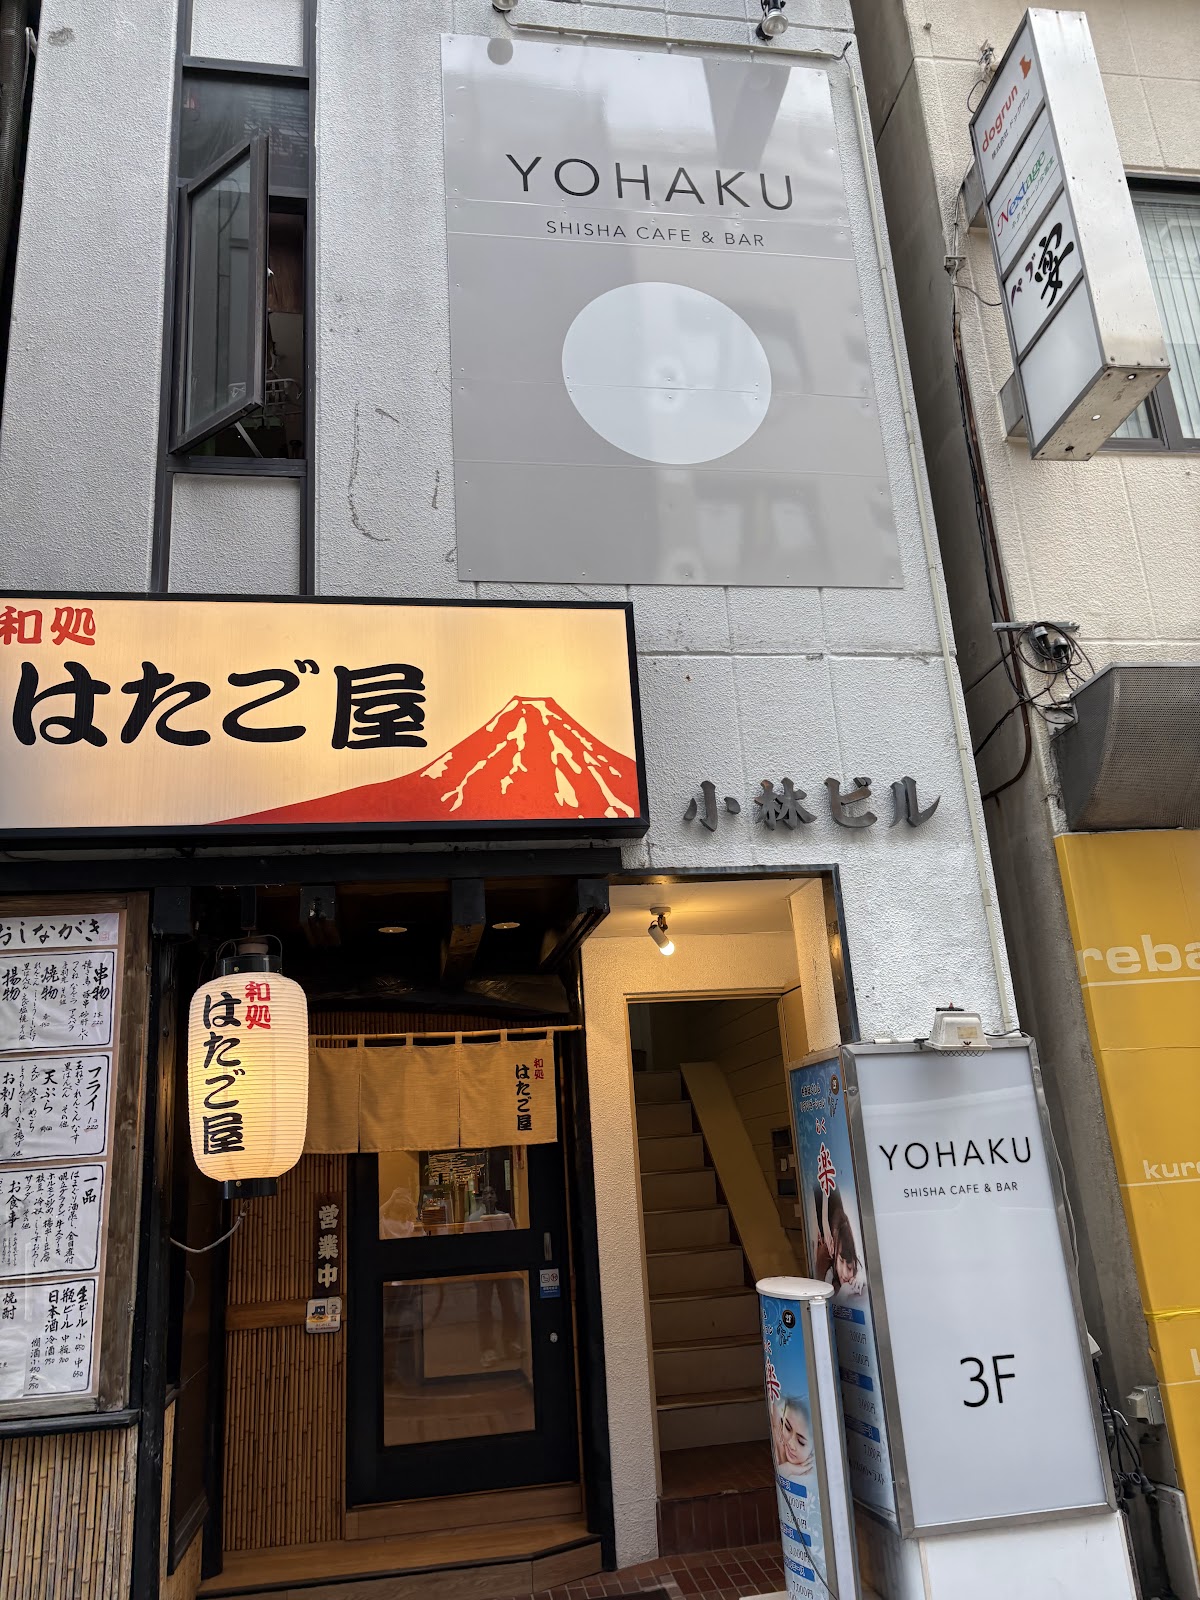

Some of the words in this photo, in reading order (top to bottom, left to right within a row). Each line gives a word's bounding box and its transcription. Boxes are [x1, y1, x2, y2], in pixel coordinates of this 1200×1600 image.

[982, 85, 1018, 152] dogrun
[505, 153, 794, 211] YOHAKU
[998, 151, 1046, 237] Nextage
[546, 220, 626, 239] SHISHA
[636, 226, 692, 242] CAFE
[701, 230, 715, 244] &
[724, 232, 765, 248] BAR
[1011, 253, 1036, 308] パブ
[0, 606, 97, 646] 和処
[12, 658, 428, 750] はたご屋
[682, 776, 942, 832] 小林ビル
[1, 965, 22, 1002] 揚物
[40, 964, 60, 1001] 焼物
[91, 962, 111, 1001] 串物
[245, 980, 272, 1030] 和処
[40, 1069, 59, 1114] 天ぷら
[84, 1066, 102, 1112] フライ
[202, 991, 246, 1156] はたご屋
[533, 1058, 545, 1080] 和処
[0, 1071, 16, 1119] お刺身
[515, 1063, 533, 1131] はたご屋
[879, 1136, 1031, 1171] YOHAKU
[3, 1180, 22, 1228] お食事
[82, 1176, 98, 1205] 一品
[903, 1186, 946, 1198] SHISHA
[950, 1183, 980, 1195] CAFE
[984, 1182, 992, 1193] &
[996, 1181, 1019, 1192] BAR
[317, 1203, 339, 1289] 営業中
[1, 1291, 17, 1320] 焼酎
[44, 1289, 60, 1333] 日本酒
[60, 1287, 77, 1330] 瓶ビール
[75, 1285, 88, 1328] 生ビール
[44, 1335, 57, 1356] 冷酒
[960, 1353, 1016, 1408] 3F
